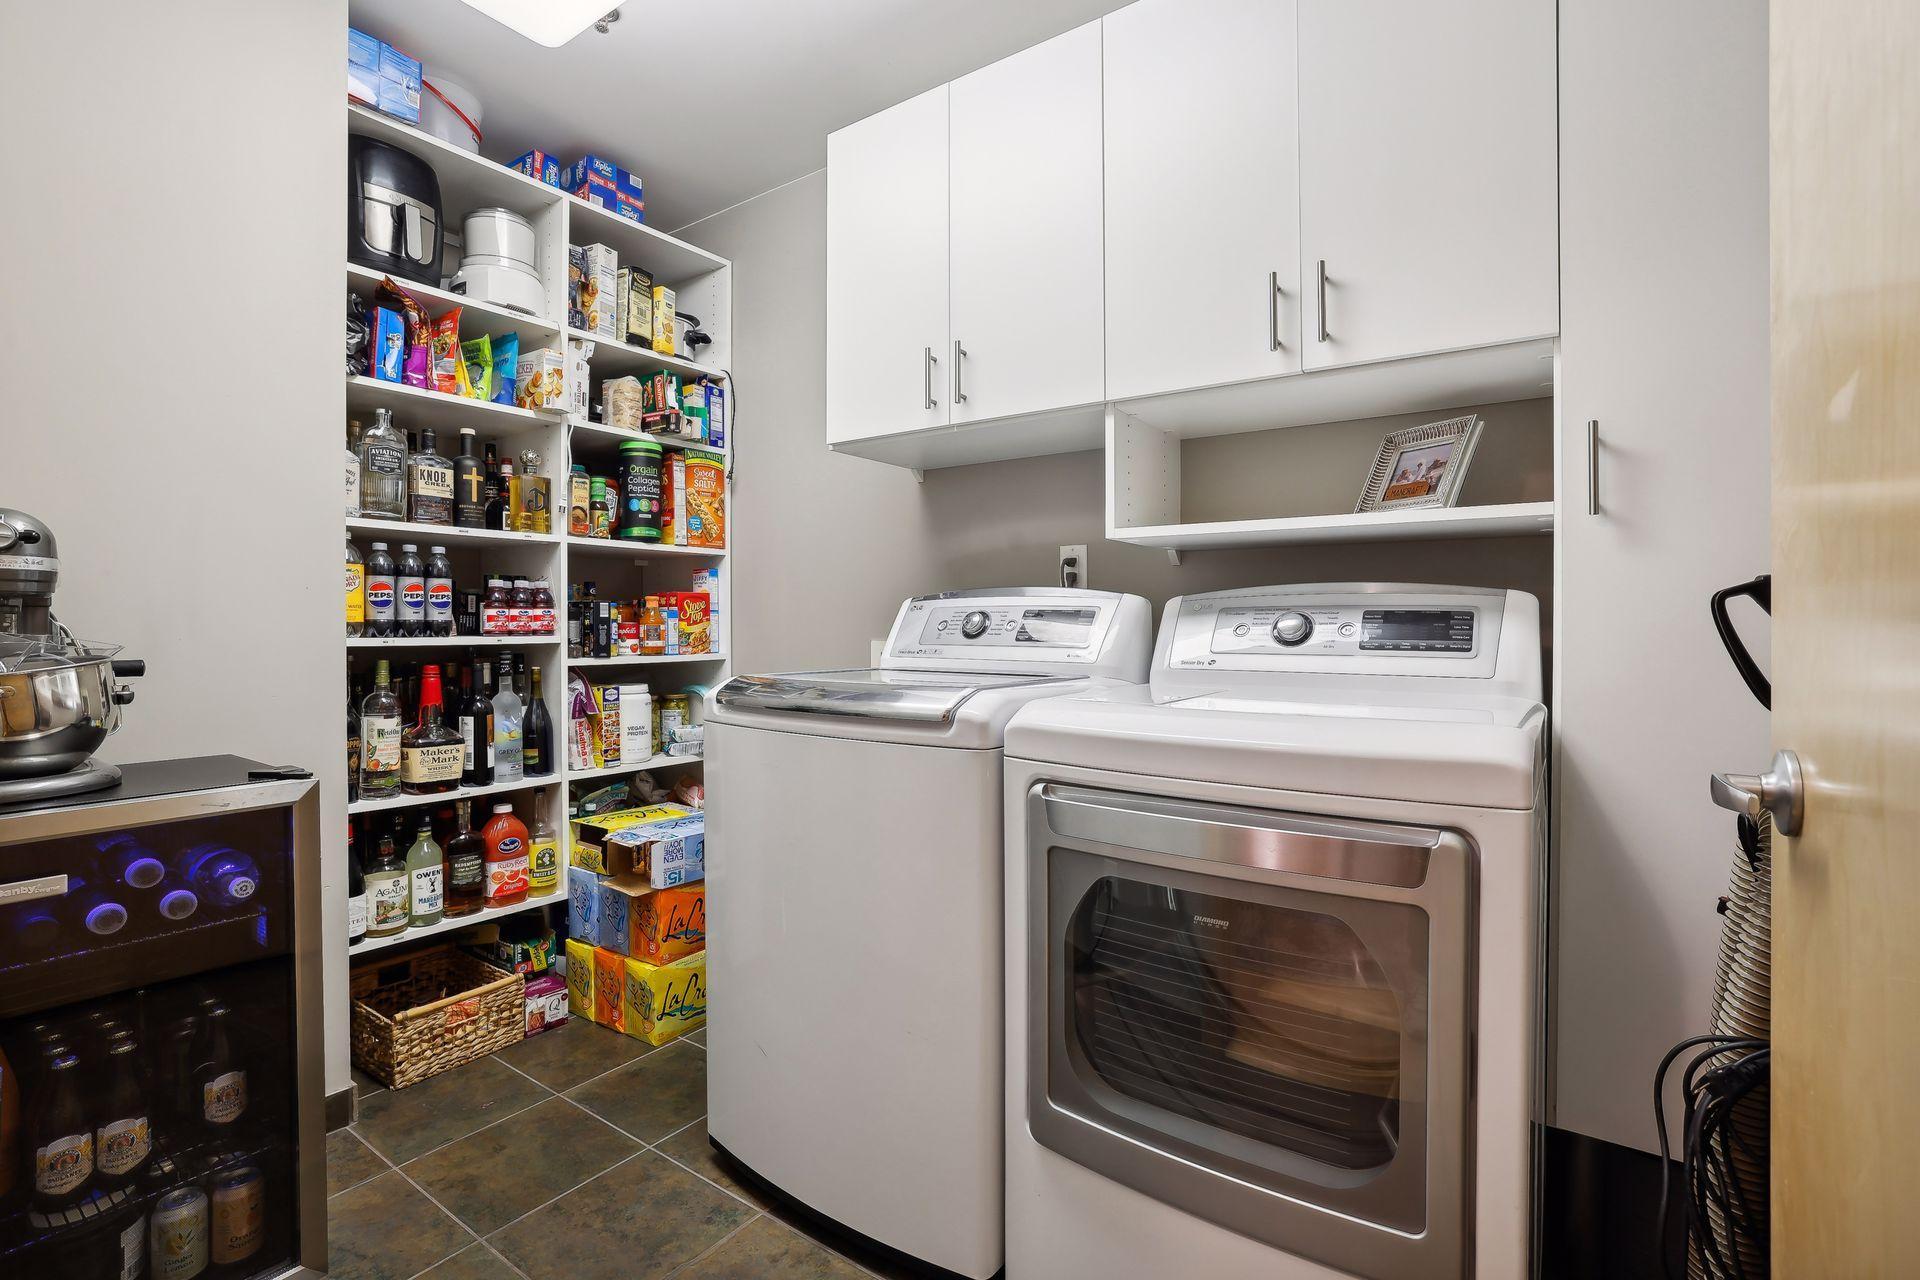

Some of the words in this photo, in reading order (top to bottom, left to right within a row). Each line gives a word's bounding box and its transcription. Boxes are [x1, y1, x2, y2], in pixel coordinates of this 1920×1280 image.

[371, 448, 402, 458] AVIATION
[687, 450, 705, 459] NATURE
[629, 464, 658, 475] Orgain
[419, 468, 447, 483] KNOB
[424, 480, 451, 489] CREEK
[627, 476, 660, 487] Collagen
[694, 479, 716, 489] SALTY
[627, 484, 660, 494] Peptides
[403, 592, 424, 600] PEPS
[681, 600, 706, 619] Stove
[689, 612, 703, 624] Top
[1196, 659, 1205, 667] Dry
[420, 747, 460, 757] Maker's
[431, 756, 460, 764] Mark
[664, 847, 684, 857] MORE
[497, 861, 515, 870] Ruby
[515, 857, 528, 868] Red
[664, 855, 684, 864] EVEN
[416, 869, 441, 880] OWEN
[668, 870, 683, 886] 15
[503, 880, 524, 891] Original
[0, 885, 36, 898] anby
[375, 885, 408, 898] AGALIM
[428, 901, 438, 909] MIX
[662, 897, 705, 943] LaCr
[1193, 915, 1230, 927] DIAMOND
[656, 973, 706, 1021] LaCro
